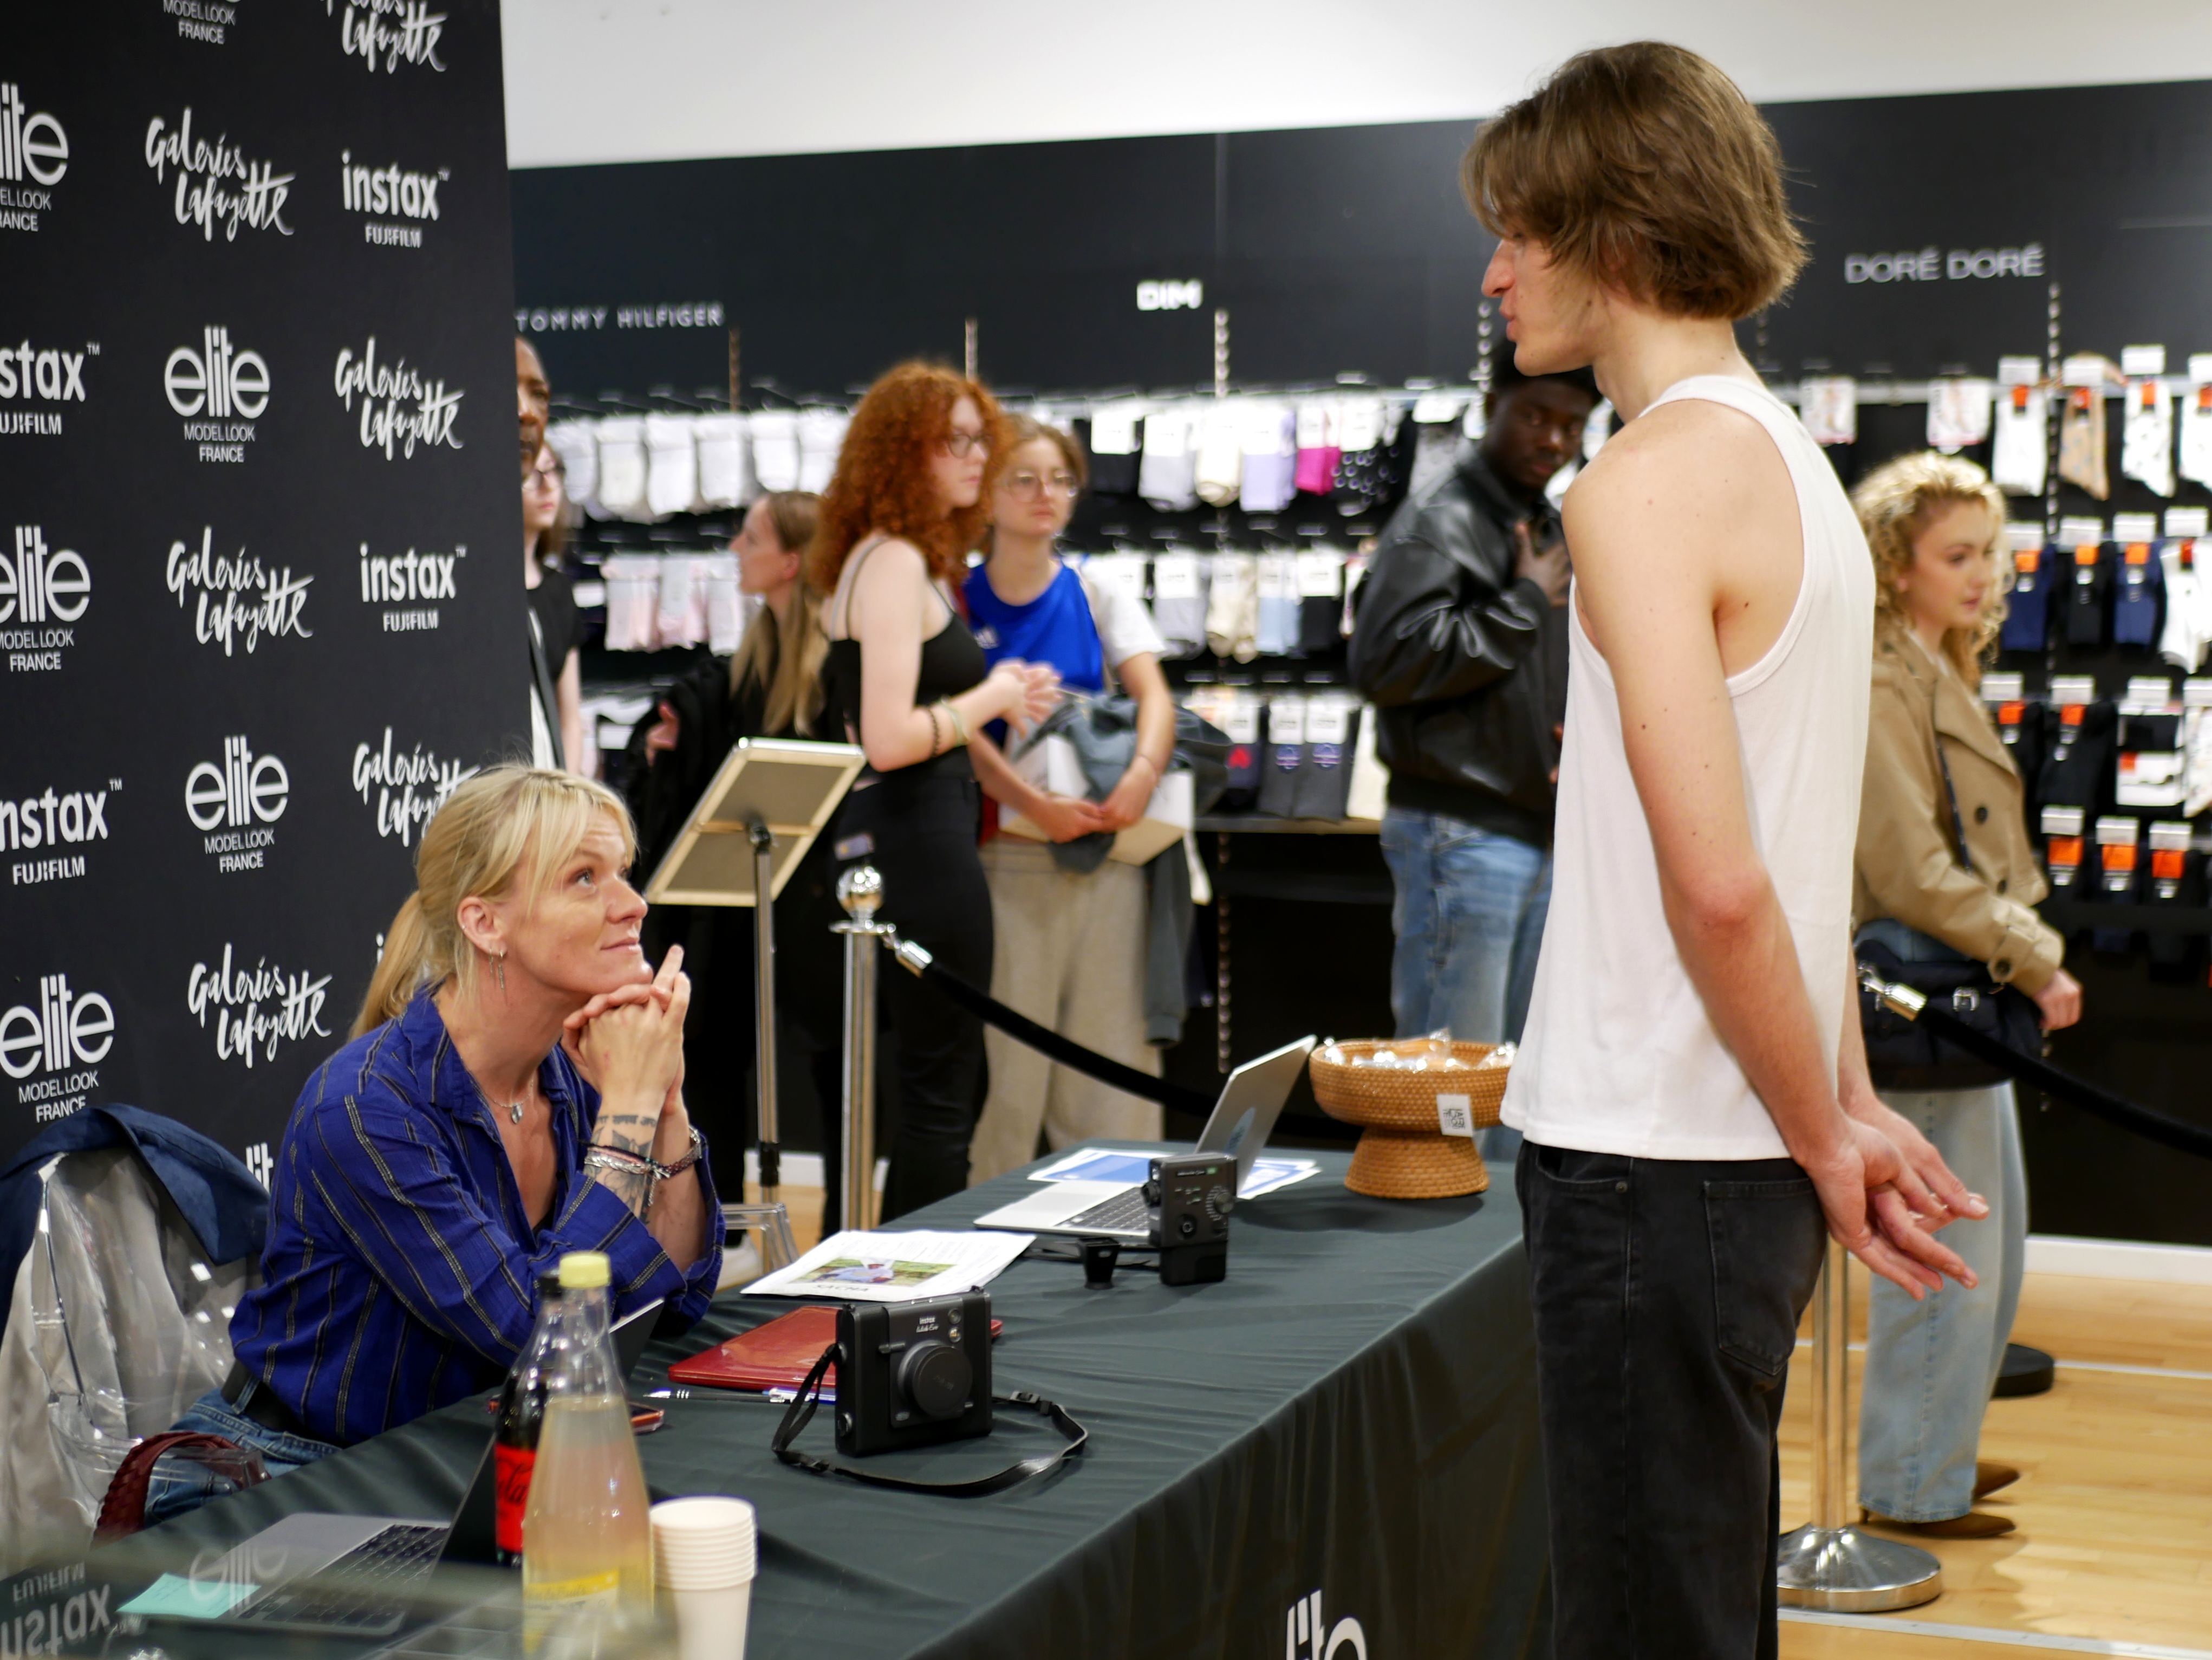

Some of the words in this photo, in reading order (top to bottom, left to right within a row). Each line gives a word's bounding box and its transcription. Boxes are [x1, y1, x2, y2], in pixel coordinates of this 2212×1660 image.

[164, 0, 204, 20] MODEL
[205, 5, 235, 25] LOOK
[178, 20, 224, 44] FRANCE
[342, 2, 447, 74] Lafayette
[145, 107, 247, 185] Galeries
[17, 191, 51, 211] LOOK
[175, 159, 295, 242] Lafayette
[342, 150, 439, 221] instax
[0, 211, 38, 232] ANCE
[365, 223, 422, 248] FUJIFILM
[1844, 245, 1942, 284] DORÉ
[1946, 242, 2046, 280] DORÉ
[1136, 278, 1203, 312] DIM
[513, 305, 609, 332] TOMMY
[616, 300, 725, 329] HILFIGER
[164, 325, 270, 419] elite
[334, 336, 422, 412] Galeries
[184, 423, 225, 442] MODEL
[225, 424, 255, 442] LOOK
[360, 379, 464, 461] Lafayette
[199, 444, 244, 463] FRANCE
[166, 526, 266, 609] Galeries
[360, 542, 457, 603] instax
[196, 566, 314, 657] Lafayette
[382, 609, 439, 633] FUJIFILM
[40, 628, 74, 648] LOOK
[9, 651, 62, 672] FRANCE
[352, 725, 439, 806] Galeries
[185, 736, 289, 832] elite
[204, 833, 245, 854] MODEL
[244, 828, 275, 849] LOOK
[12, 855, 85, 885] FUJIFILM
[219, 850, 264, 873] FRANCE
[187, 942, 286, 1028] Galeries
[0, 972, 115, 1079] elite
[217, 970, 333, 1068] Lafayette
[18, 1079, 64, 1104] MODEL
[64, 1070, 99, 1094] LOOK
[35, 1095, 86, 1124] FRANCE
